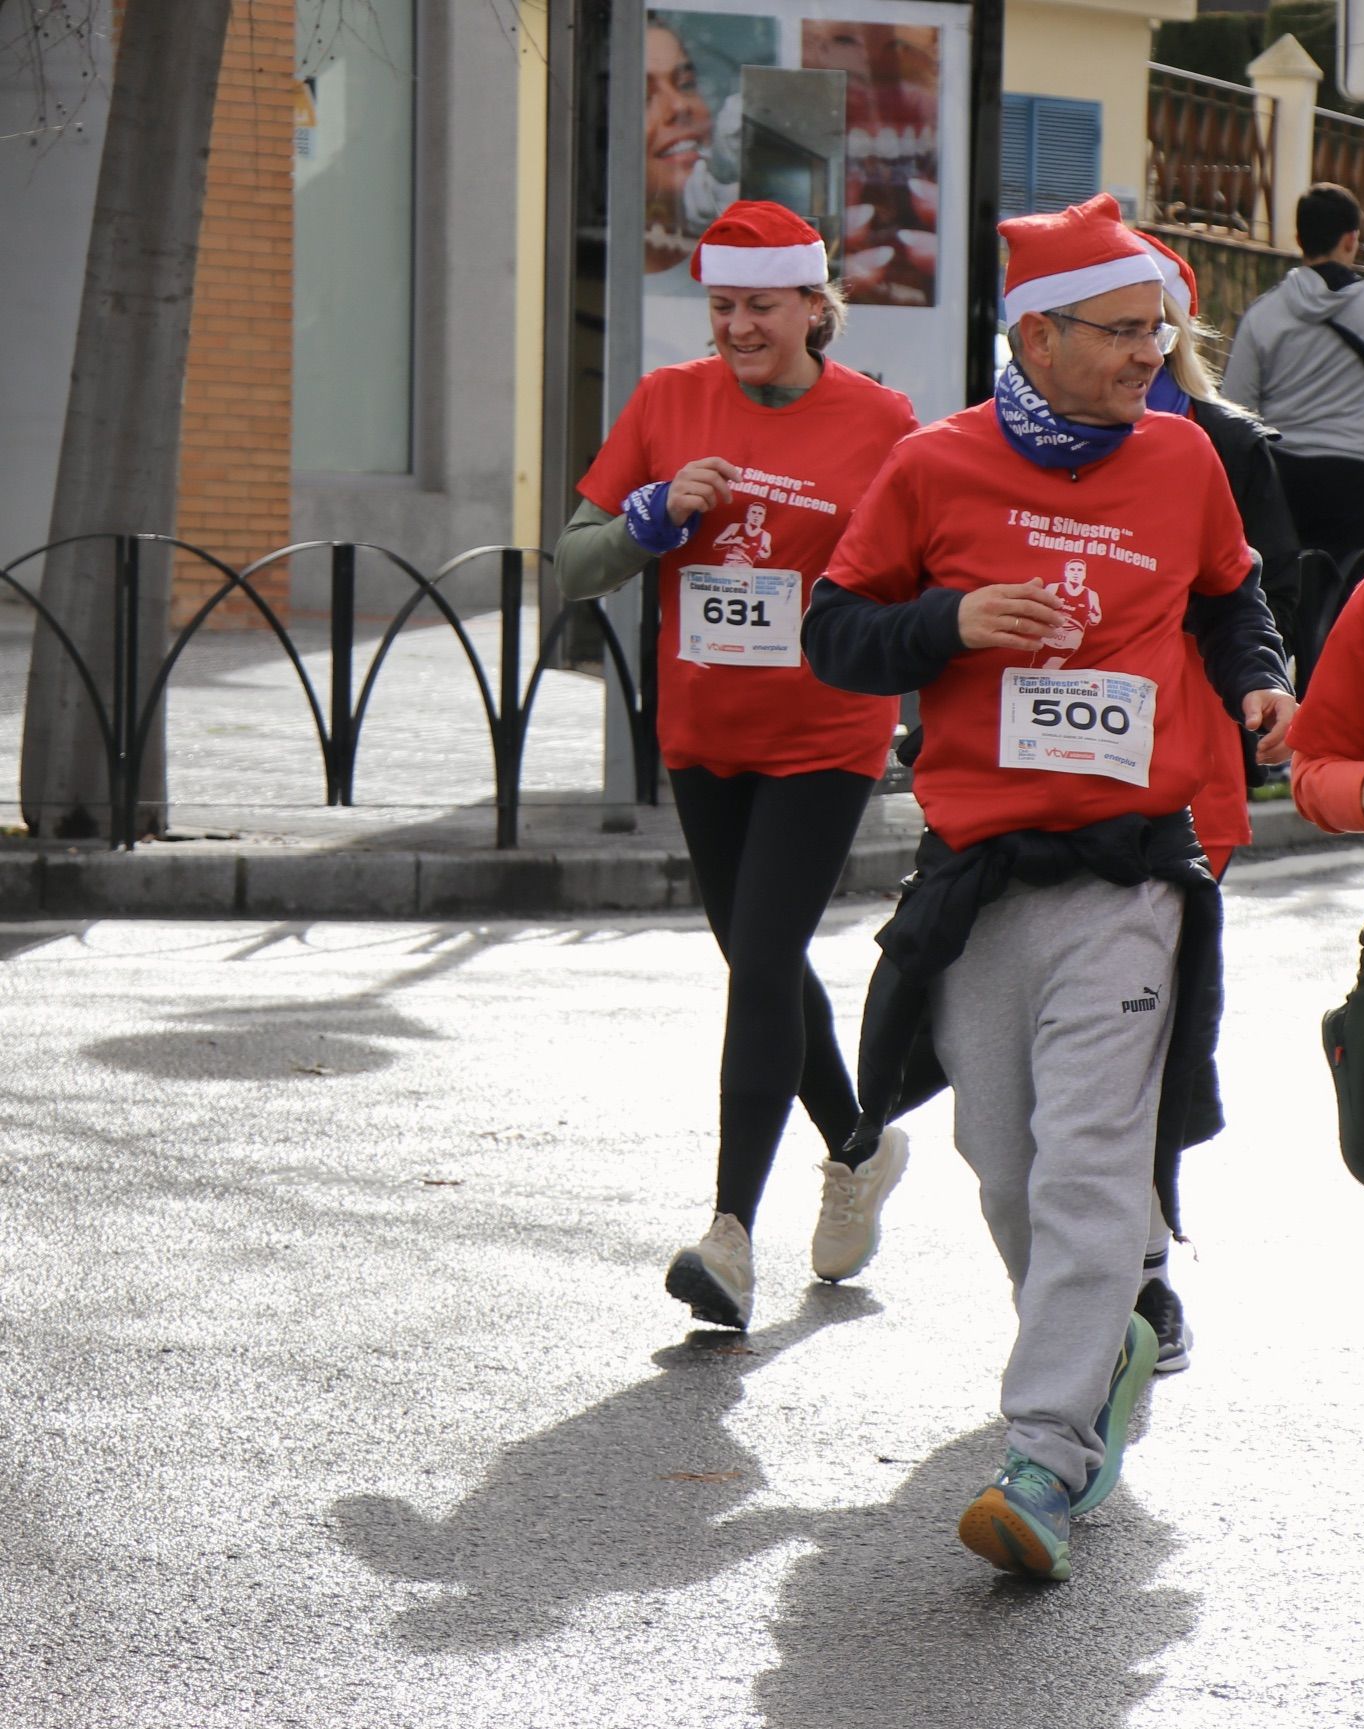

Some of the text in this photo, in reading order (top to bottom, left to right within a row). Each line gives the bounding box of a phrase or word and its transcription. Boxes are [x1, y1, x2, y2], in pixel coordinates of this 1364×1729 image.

[743, 466, 802, 491] Silvestre
[726, 480, 837, 515] iudad de Lucena
[1008, 509, 1018, 525] I
[1020, 511, 1050, 531] San
[1053, 516, 1121, 541] Silvestre
[1028, 531, 1157, 572] Ciudad de Lucena
[703, 597, 771, 627] 631
[1019, 686, 1098, 697] Ciudad de Lucena
[1020, 679, 1038, 687] San
[1040, 679, 1080, 687] Silvestre
[1031, 699, 1130, 736] 500
[1121, 997, 1156, 1013] PUMA
